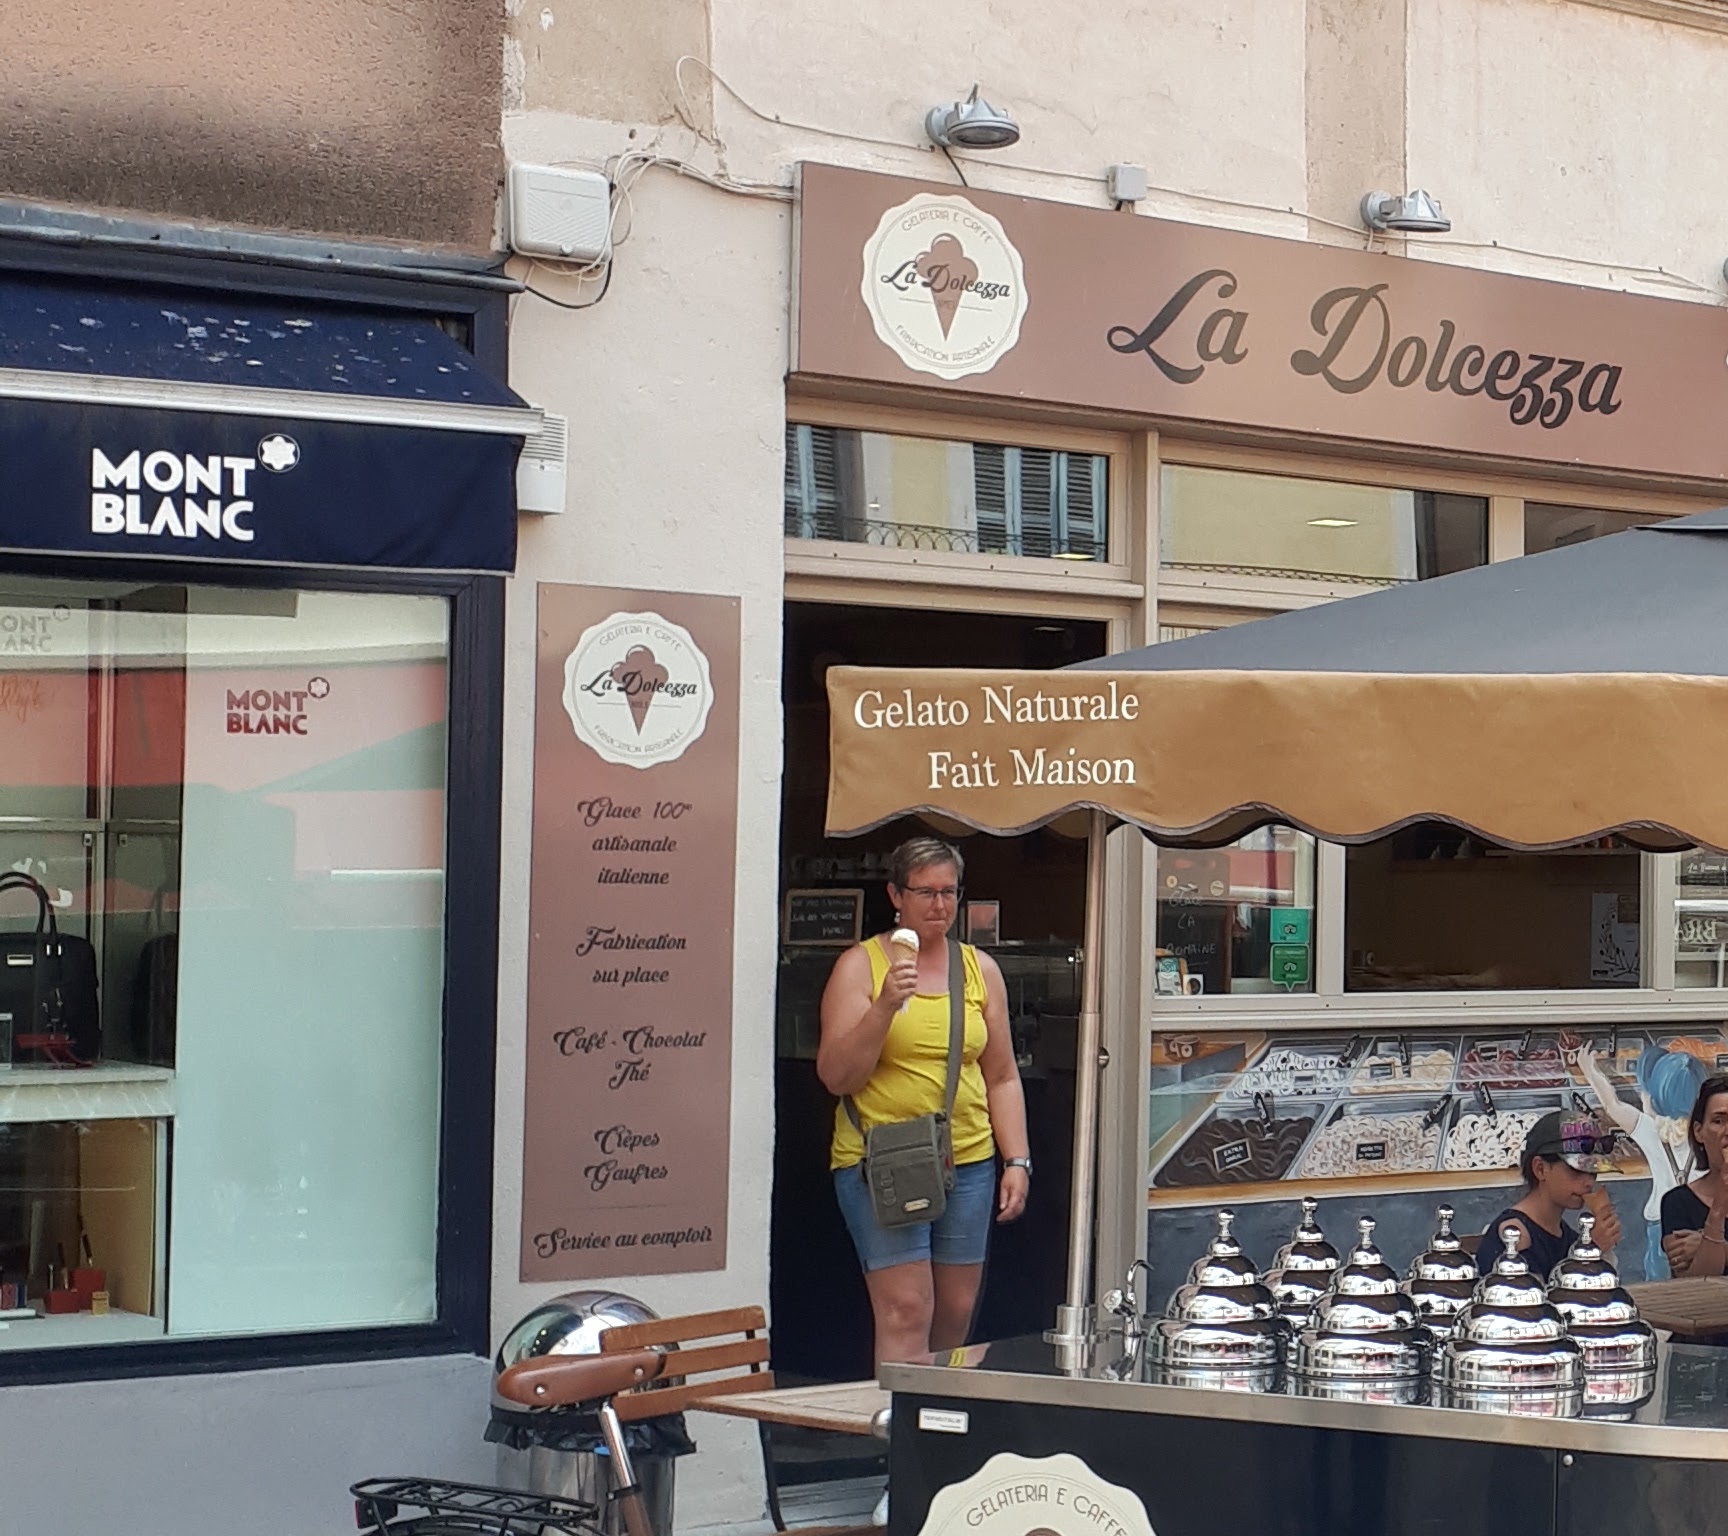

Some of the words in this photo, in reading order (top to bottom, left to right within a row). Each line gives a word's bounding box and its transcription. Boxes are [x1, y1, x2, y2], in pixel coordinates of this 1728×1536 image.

[880, 261, 917, 291] La
[922, 264, 1011, 300] Dolcezza
[1107, 269, 1248, 385] La
[1290, 283, 1622, 428] Dolcezza
[91, 447, 256, 497] MONT
[91, 493, 255, 542] BLANC
[0, 615, 51, 633] ONT
[2, 634, 52, 652] ANC
[580, 670, 613, 697] La
[617, 670, 698, 697] Dolcezza
[226, 687, 308, 713] MONT
[854, 688, 970, 728] Gelato
[980, 681, 1140, 724] Naturale
[226, 712, 308, 736] BLANC
[927, 750, 1000, 789] Fait
[1009, 747, 1136, 787] Maison
[577, 797, 642, 828] Glace
[592, 835, 677, 853] artisanale
[597, 867, 670, 885] italienne
[576, 926, 687, 957] Fabrication
[593, 967, 620, 983] sur
[622, 967, 669, 987] place
[553, 1026, 608, 1056] Café
[622, 1024, 708, 1055] Chocolat
[608, 1058, 652, 1090] Thé
[583, 1159, 668, 1192] Gaufres
[533, 1227, 611, 1259] Service
[615, 1230, 637, 1248] au
[641, 1225, 713, 1249] comptoir
[966, 1484, 1049, 1527] GELATERIA
[1056, 1487, 1066, 1505] E
